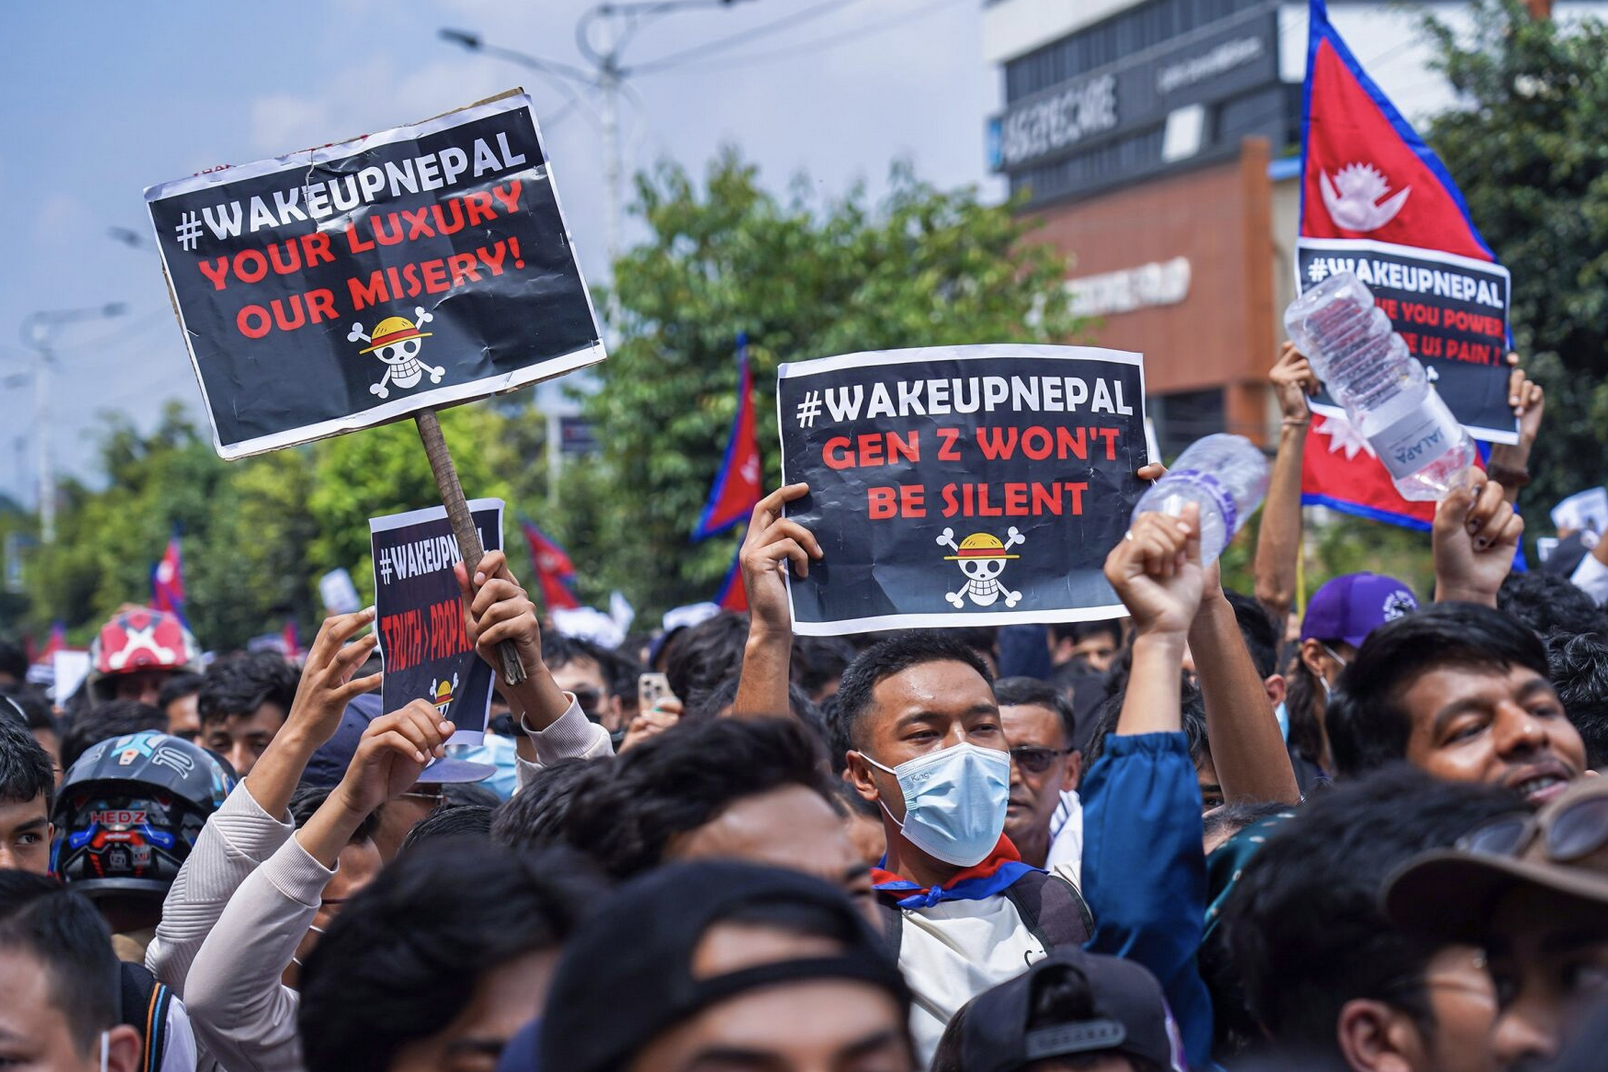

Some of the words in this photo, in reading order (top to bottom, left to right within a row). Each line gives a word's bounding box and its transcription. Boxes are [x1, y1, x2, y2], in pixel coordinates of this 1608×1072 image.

[176, 132, 526, 252] #WAKEUPNEPAL
[198, 231, 335, 292] YOUR
[346, 180, 523, 254] LUXURY
[236, 288, 340, 339] OUR
[346, 236, 526, 312] MISERY!
[1308, 258, 1504, 309] #WAKEUPNEPAL
[1401, 302, 1439, 327] YOU
[1422, 335, 1442, 357] US
[1446, 338, 1491, 365] PAIN
[796, 376, 1133, 428] #WAKEUPNEPAL
[822, 430, 920, 470] GEN
[936, 427, 961, 461] Z
[976, 425, 1120, 461] WON'T
[867, 484, 926, 520] BE
[941, 481, 1089, 518] SILENT
[379, 527, 489, 585] #WAKEUPNL
[381, 609, 422, 674] TRUTH
[430, 596, 474, 661] PROPA
[91, 811, 147, 824] HEDZ
